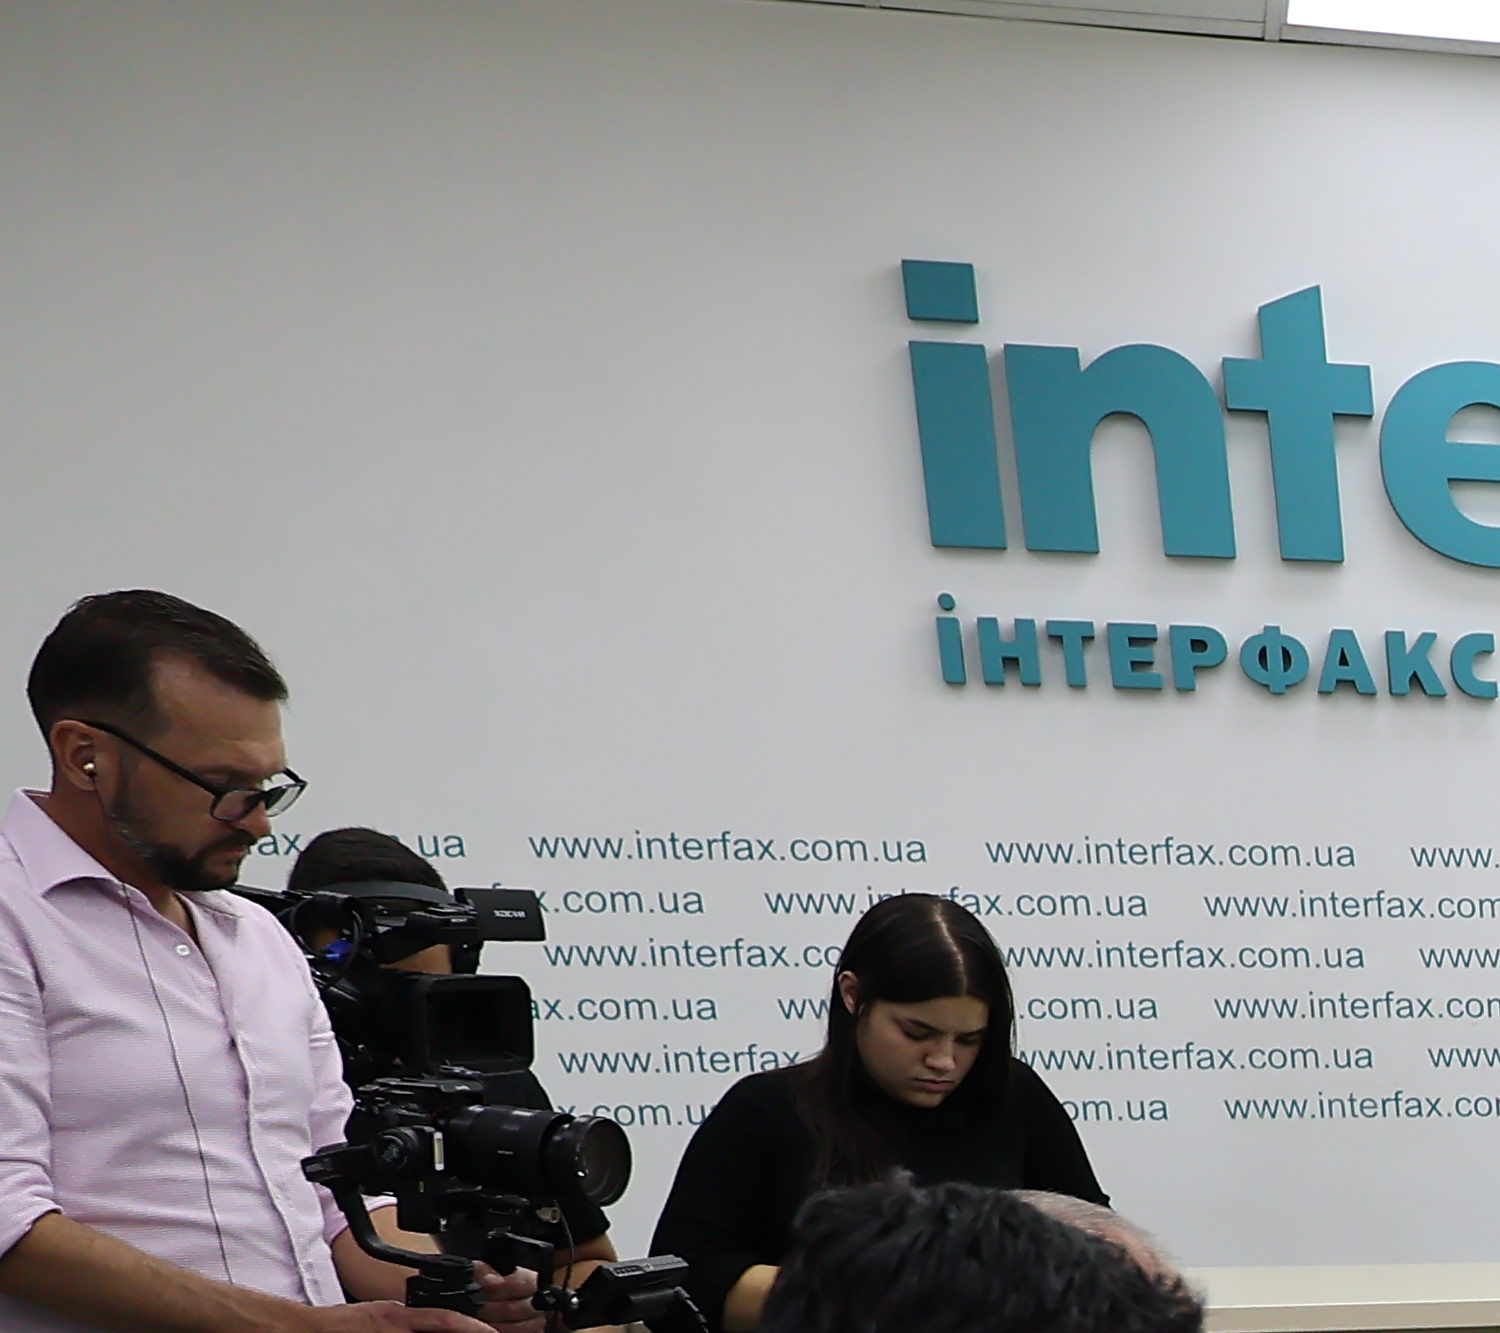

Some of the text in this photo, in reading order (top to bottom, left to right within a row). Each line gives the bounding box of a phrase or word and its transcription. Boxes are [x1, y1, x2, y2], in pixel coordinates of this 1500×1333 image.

[528, 829, 927, 863] www.interfax.com.ua
[985, 835, 1355, 867] www.interfax.com.ua
[542, 937, 838, 968] www.interfax.co
[558, 1043, 799, 1075] www.interfax
